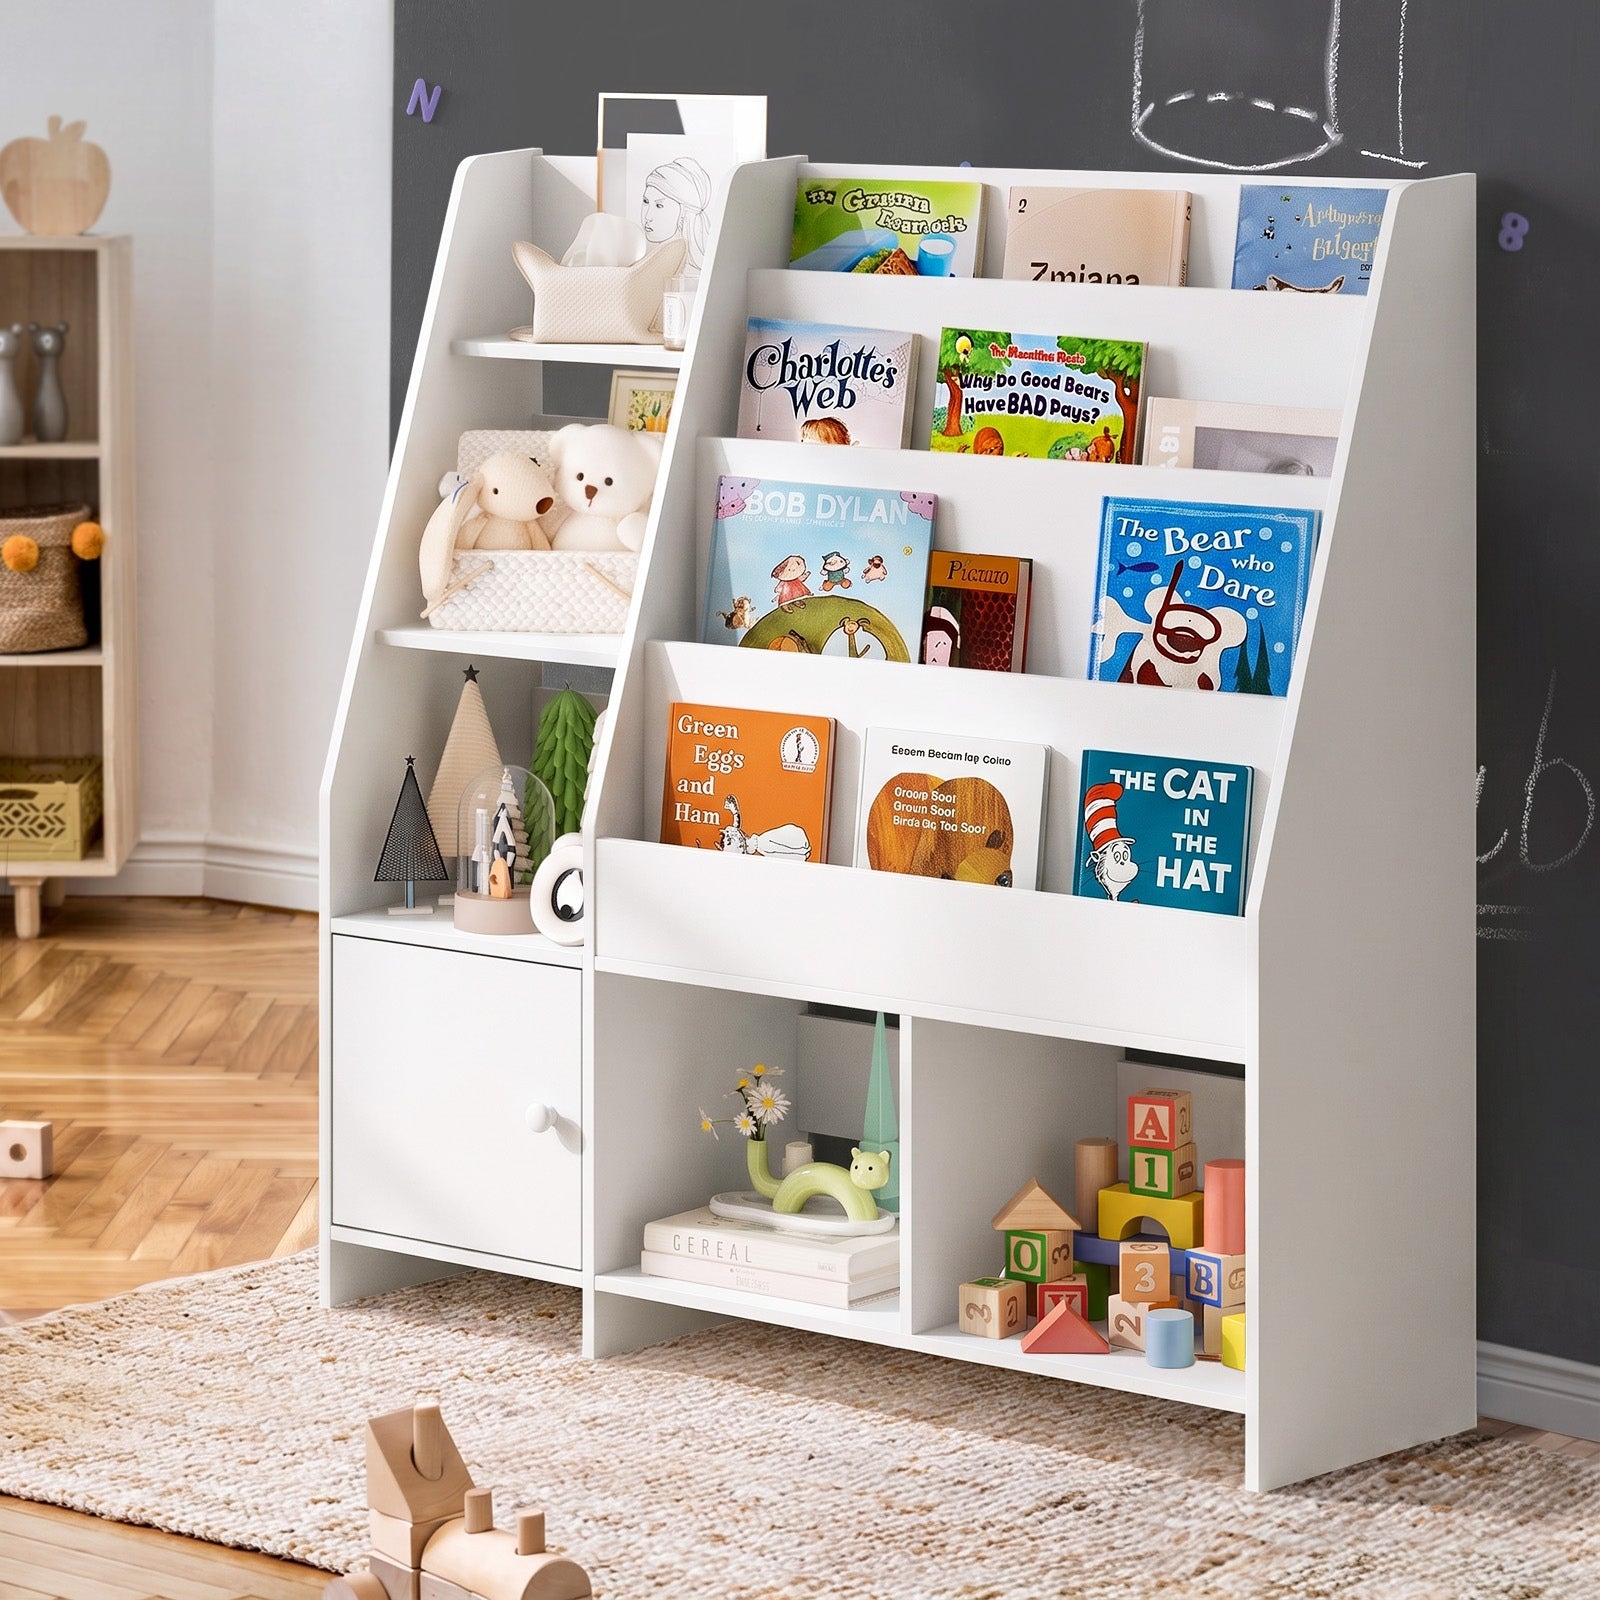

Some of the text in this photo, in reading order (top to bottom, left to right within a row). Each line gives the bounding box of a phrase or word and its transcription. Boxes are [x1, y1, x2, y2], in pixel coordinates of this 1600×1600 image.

[406, 78, 442, 123] N
[1018, 198, 1028, 214] 2
[1498, 212, 1529, 251] 8
[746, 336, 898, 390] Charlotte's
[784, 376, 857, 419] Web
[959, 371, 1110, 403] Why Do Good Bears
[964, 398, 1006, 414] Have
[1007, 393, 1047, 417] BAD
[744, 490, 806, 518] BOB
[815, 494, 909, 525] DYLAN
[1117, 517, 1252, 556] The Bear
[1231, 554, 1275, 572] who
[1197, 565, 1276, 607] Dare
[677, 714, 739, 739] Green
[694, 744, 745, 774] Eggs
[677, 776, 715, 795] and
[1109, 767, 1237, 804] THE CAT
[675, 802, 721, 825] Ham
[1184, 808, 1210, 827] IN
[1171, 832, 1218, 855] THE
[1156, 856, 1232, 894] HAT
[1136, 1106, 1167, 1140] A
[1144, 1157, 1158, 1188] 1
[1135, 1262, 1155, 1292] 3
[1194, 1262, 1213, 1295] B
